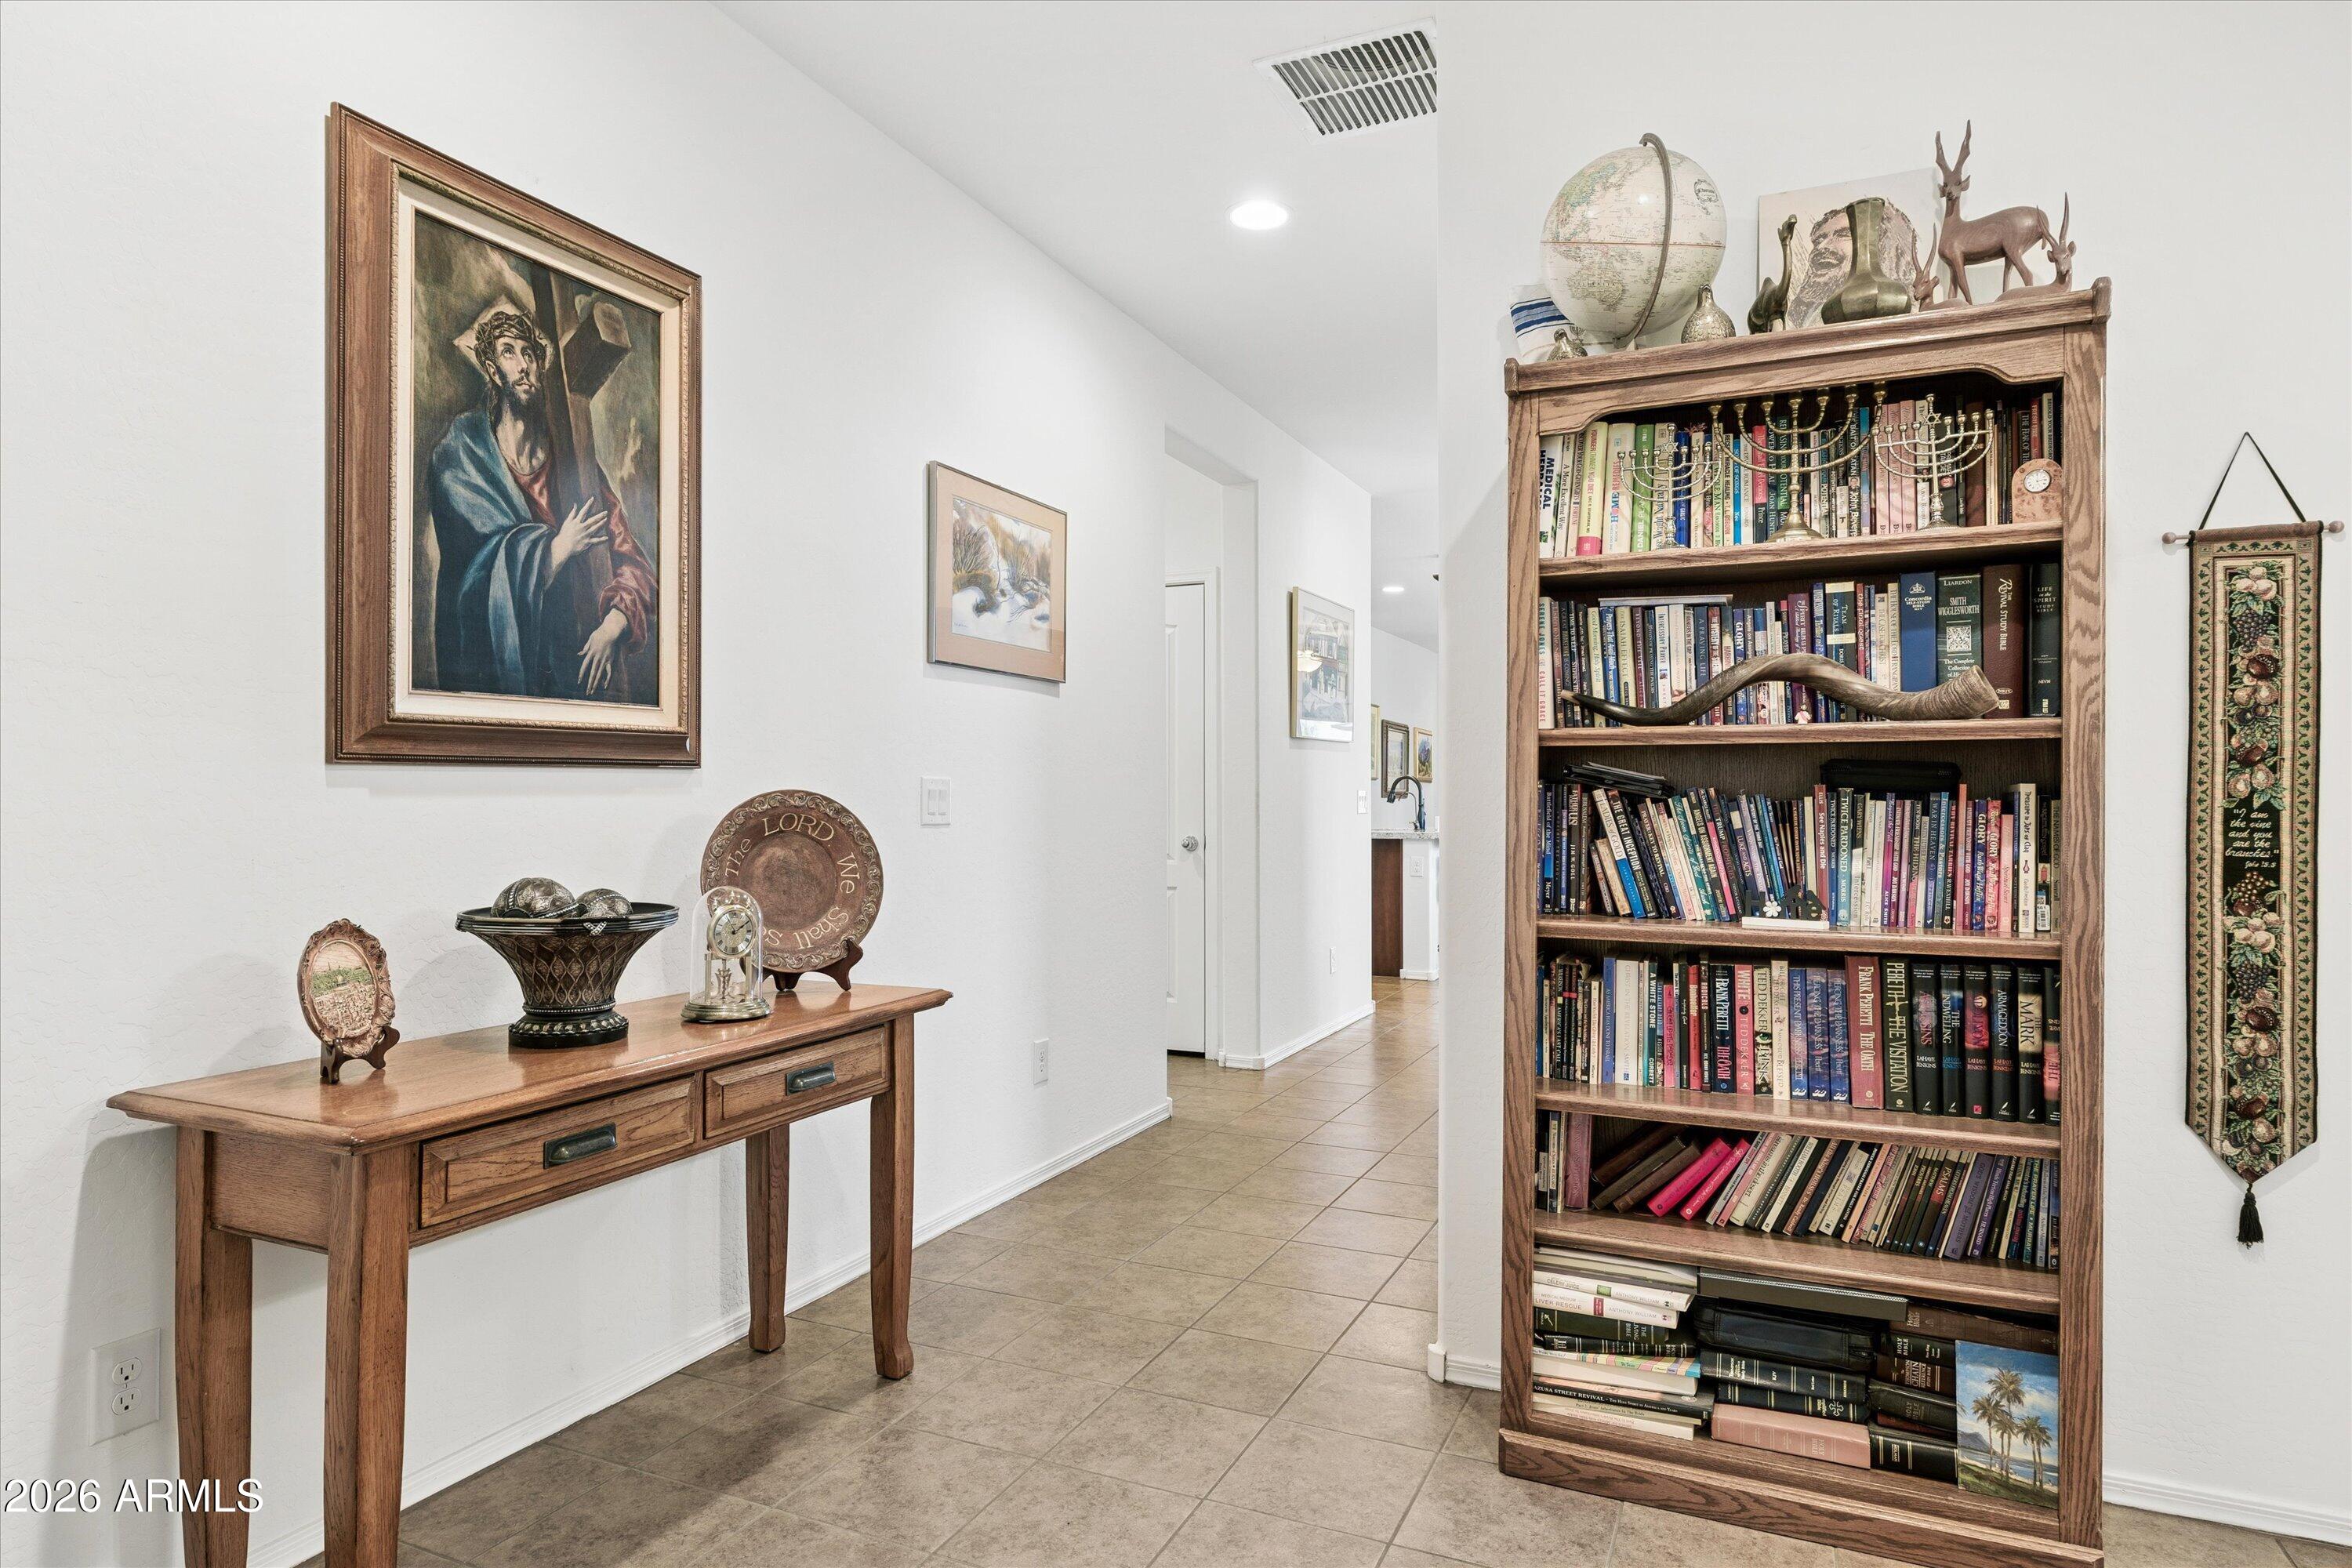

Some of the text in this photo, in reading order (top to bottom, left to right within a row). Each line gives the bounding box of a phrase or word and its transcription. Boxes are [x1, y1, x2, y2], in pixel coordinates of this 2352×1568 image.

[1543, 457, 1555, 509] MEDICAL
[1849, 491, 1860, 537] John Bevere
[1949, 597, 1967, 605] SMITH
[1998, 579, 2013, 608] REVIVAL
[1591, 611, 1599, 626] Good
[1937, 607, 1979, 615] WIGGLESWORTH
[1999, 610, 2008, 632] STUDY
[1592, 627, 1600, 652] Morning,
[1619, 621, 1628, 648] ISAIAH
[1711, 623, 1720, 644] MYSTERY
[1735, 622, 1744, 651] GLORY
[761, 813, 834, 841] LORD
[1599, 802, 1623, 858] LADIES GOLD
[1817, 825, 1826, 845] Naples
[1840, 797, 1849, 872] TWICE PARDONED
[2253, 831, 2273, 840] you
[724, 838, 753, 877] The
[1623, 837, 1642, 871] INCEPTION
[1715, 817, 1736, 879] TRUMP PROPHECIES
[1737, 835, 1751, 877] LUKE ACTS
[2254, 839, 2270, 848] the
[837, 851, 861, 894] We
[793, 906, 849, 949] Shall
[1737, 970, 1751, 1000] WHITE
[1792, 975, 1801, 989] THIS
[1858, 965, 1875, 1026] FRANK PERETTI
[1886, 963, 1905, 998] PERETTI
[1690, 984, 1698, 1016] Bonhoeffer
[1715, 978, 1729, 1030] FRANK PERETTI
[1758, 971, 1769, 1032] TED DEKKER
[1919, 990, 1932, 1045] ASSASSINS
[1942, 993, 1951, 1044] INDWELLING
[1951, 1010, 1960, 1027] THE
[1998, 989, 2008, 1047] ARMAGEDDON
[2020, 1000, 2034, 1046] MARK
[1717, 1045, 1732, 1079] THE OATH
[1860, 1032, 1876, 1072] THE OATH
[1889, 1016, 1908, 1093] THE VISITATION
[1915, 1165, 1926, 1186] PROVERBS
[1928, 1167, 1939, 1187] MATTHEW
[1936, 1167, 1952, 1195] PSALMS
[1955, 1214, 1969, 1243] MOTHERS
[1555, 1301, 1582, 1310] RESCUE
[1555, 1388, 1577, 1397] STREET
[1578, 1393, 1605, 1402] REVIVAL
